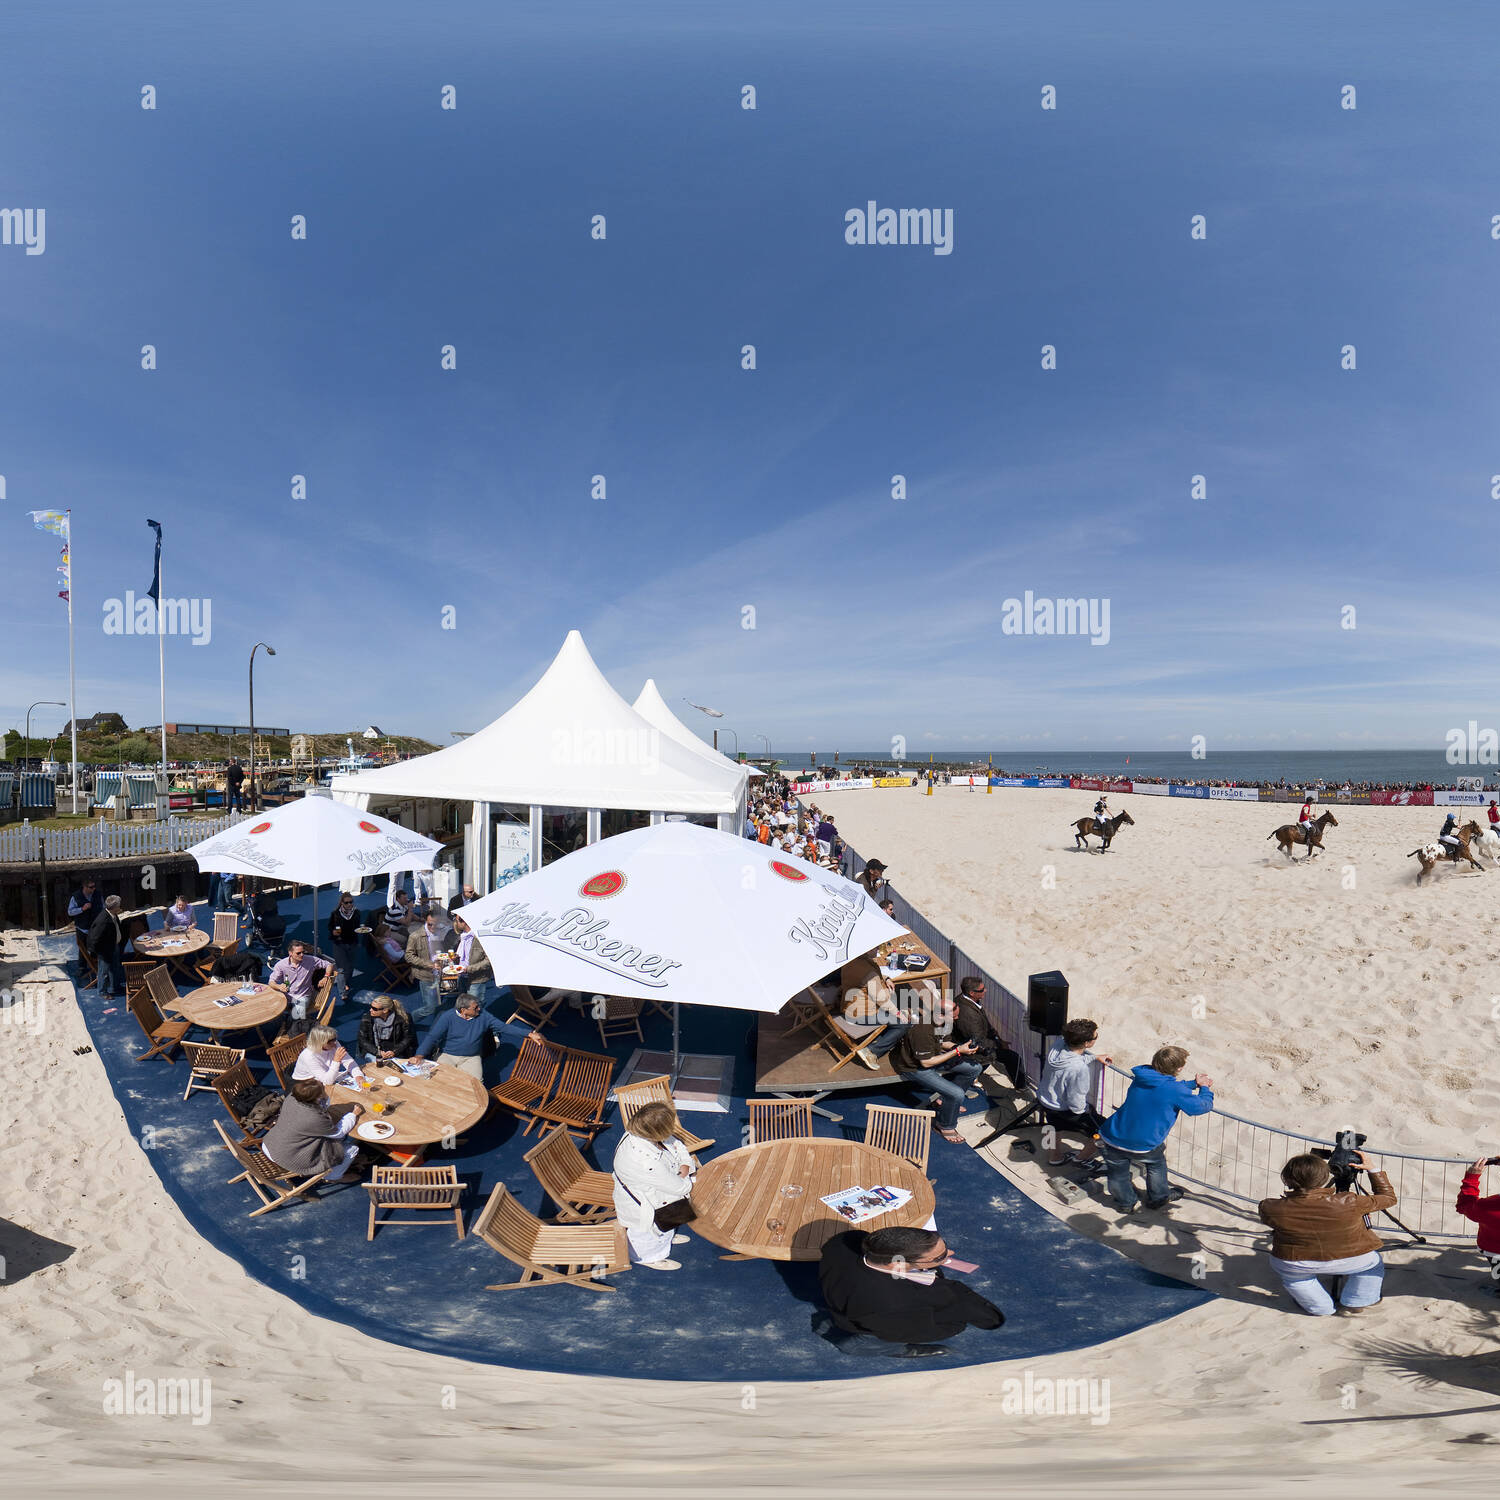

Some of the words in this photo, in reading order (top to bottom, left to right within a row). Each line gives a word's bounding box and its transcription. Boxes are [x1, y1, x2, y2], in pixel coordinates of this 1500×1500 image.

[1211, 789, 1246, 798] OFFSDE.
[1475, 779, 1482, 788] 0
[347, 844, 400, 872] König
[482, 901, 556, 940] König
[552, 906, 683, 980] Pilsener
[788, 898, 858, 962] König
